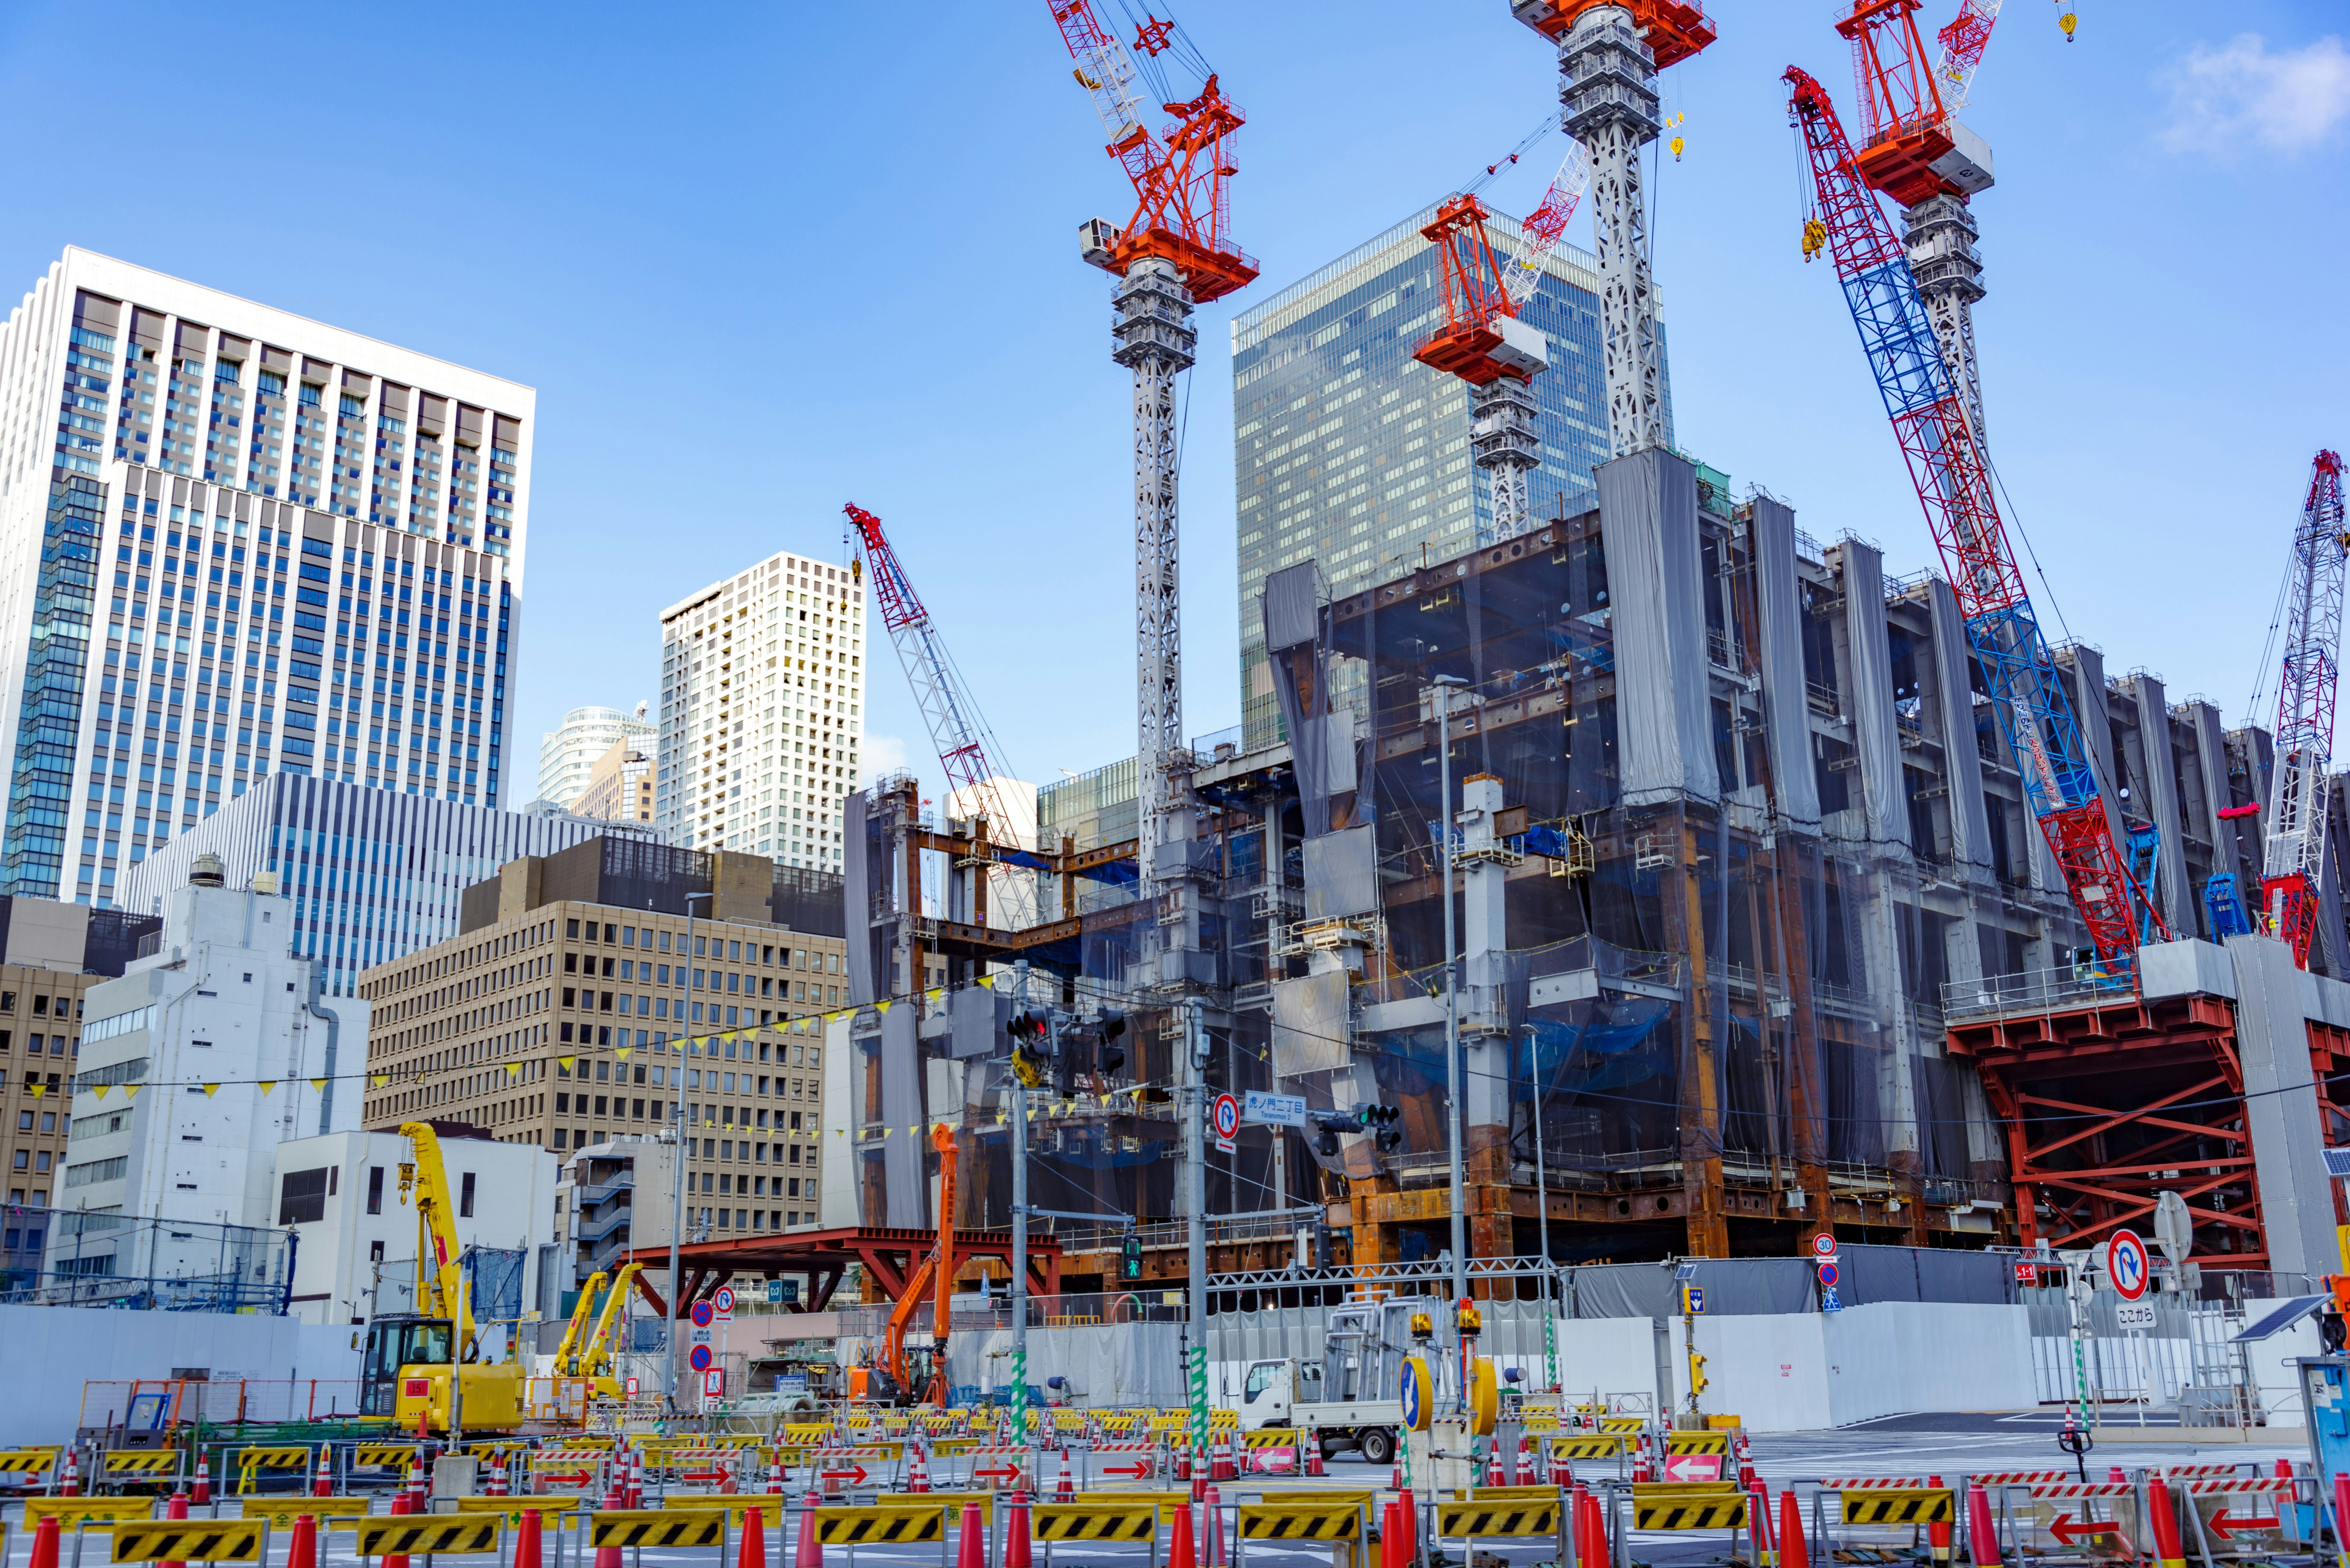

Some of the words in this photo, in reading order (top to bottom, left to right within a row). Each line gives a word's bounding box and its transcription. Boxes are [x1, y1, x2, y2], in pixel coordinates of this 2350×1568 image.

[1249, 1096, 1302, 1114] 虎ノ門二丁目
[1261, 1111, 1286, 1120] Toranomon
[1818, 1240, 1832, 1250] 30
[2017, 1266, 2033, 1277] A-1-1
[2119, 1307, 2154, 1324] ここから
[412, 1383, 421, 1394] 15
[2314, 1383, 2324, 1394] 14
